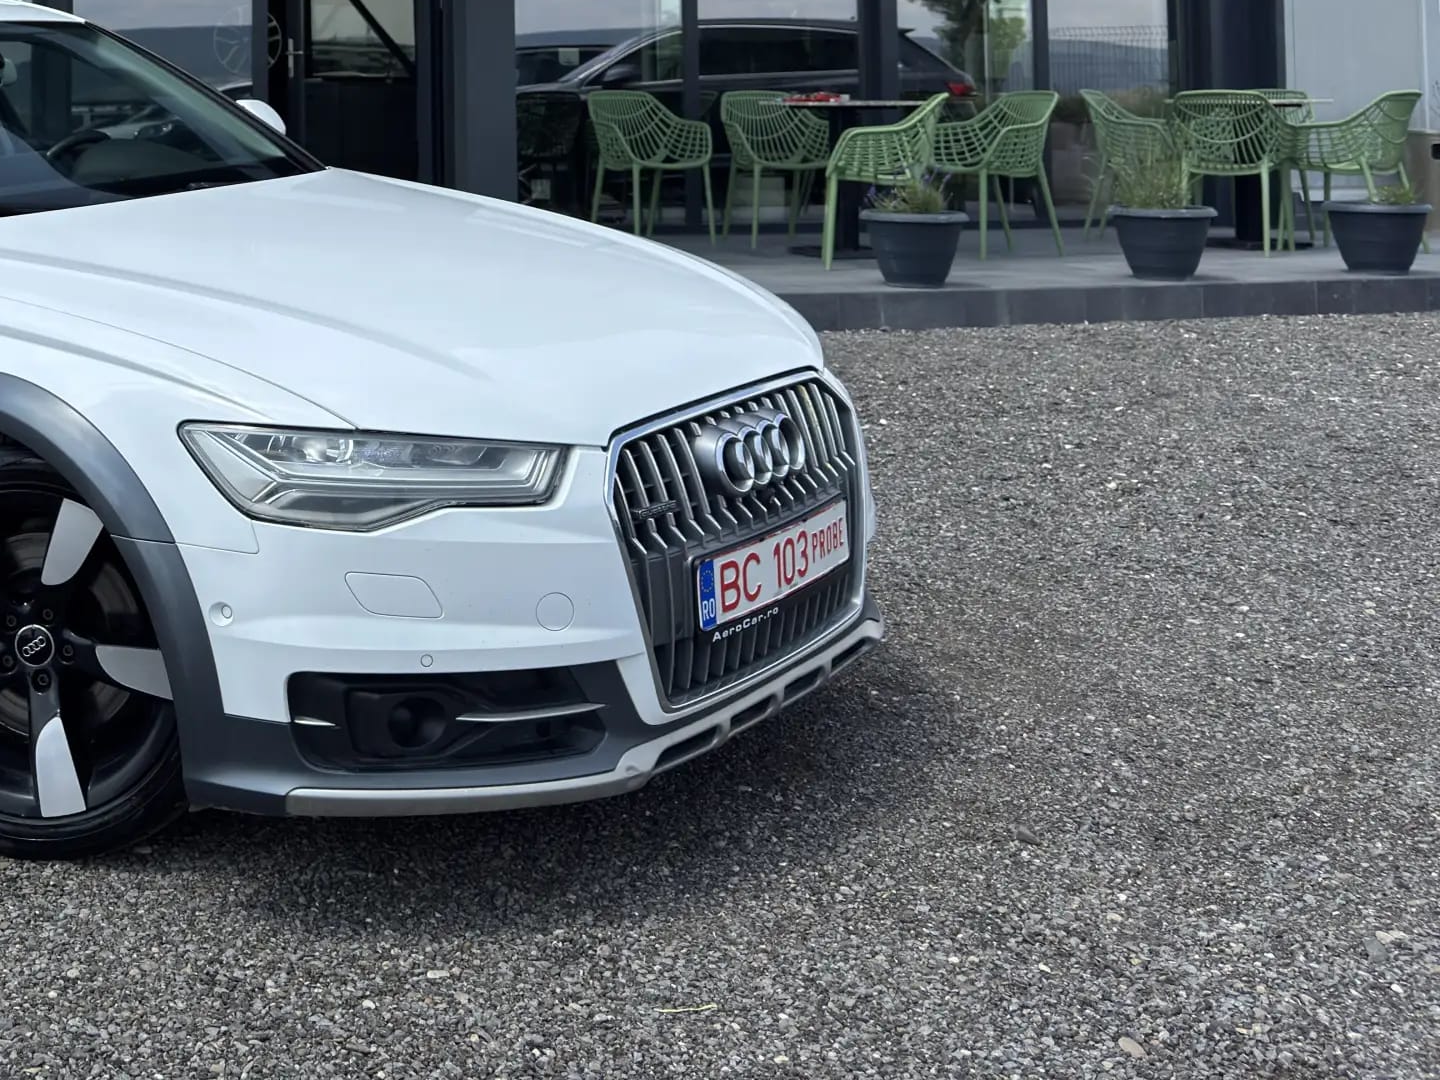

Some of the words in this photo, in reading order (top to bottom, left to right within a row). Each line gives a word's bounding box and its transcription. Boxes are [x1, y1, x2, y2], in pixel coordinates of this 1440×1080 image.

[720, 552, 762, 613] BC
[773, 530, 808, 588] 103
[811, 517, 844, 563] PROBE
[702, 598, 716, 621] RO
[712, 607, 779, 642] AeroCar.ro
